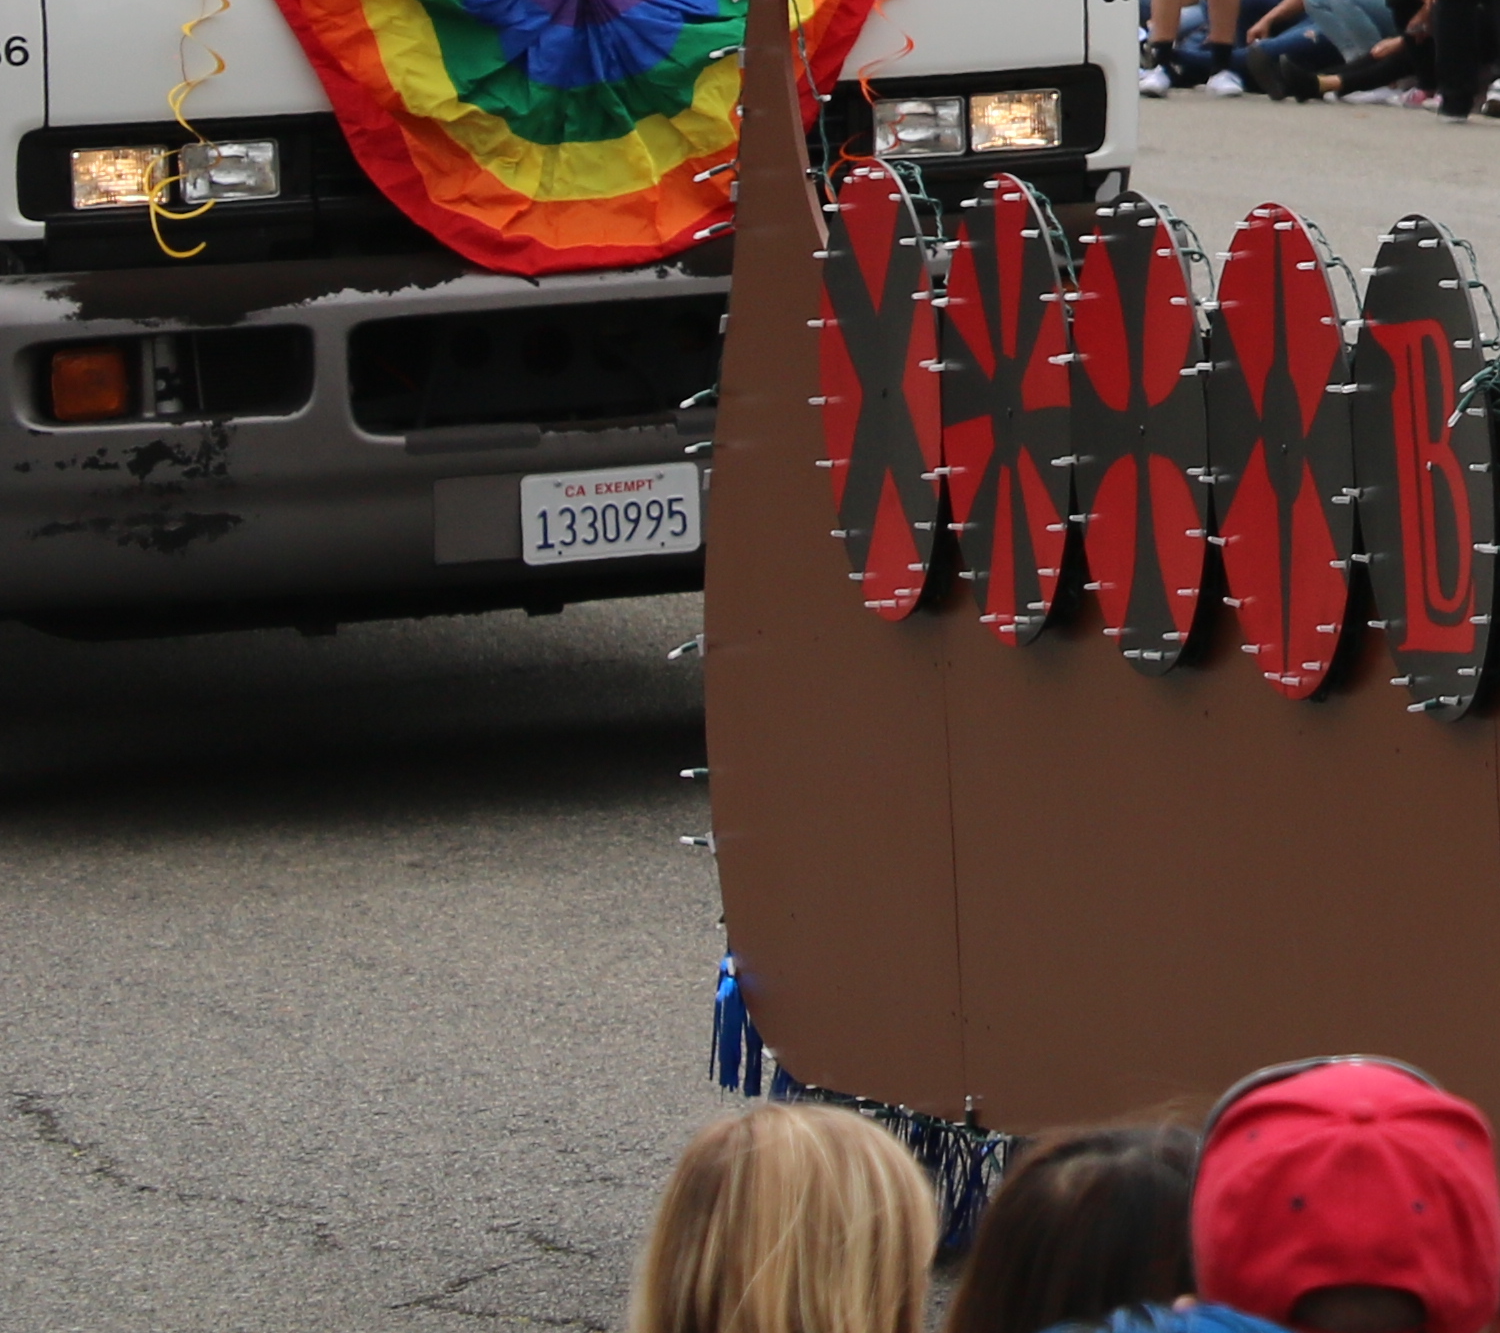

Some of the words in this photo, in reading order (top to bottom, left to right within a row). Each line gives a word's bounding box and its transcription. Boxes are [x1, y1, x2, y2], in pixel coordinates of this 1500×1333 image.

[565, 485, 586, 498] CA
[595, 479, 654, 495] EXEMPT
[536, 497, 688, 551] 1330995
